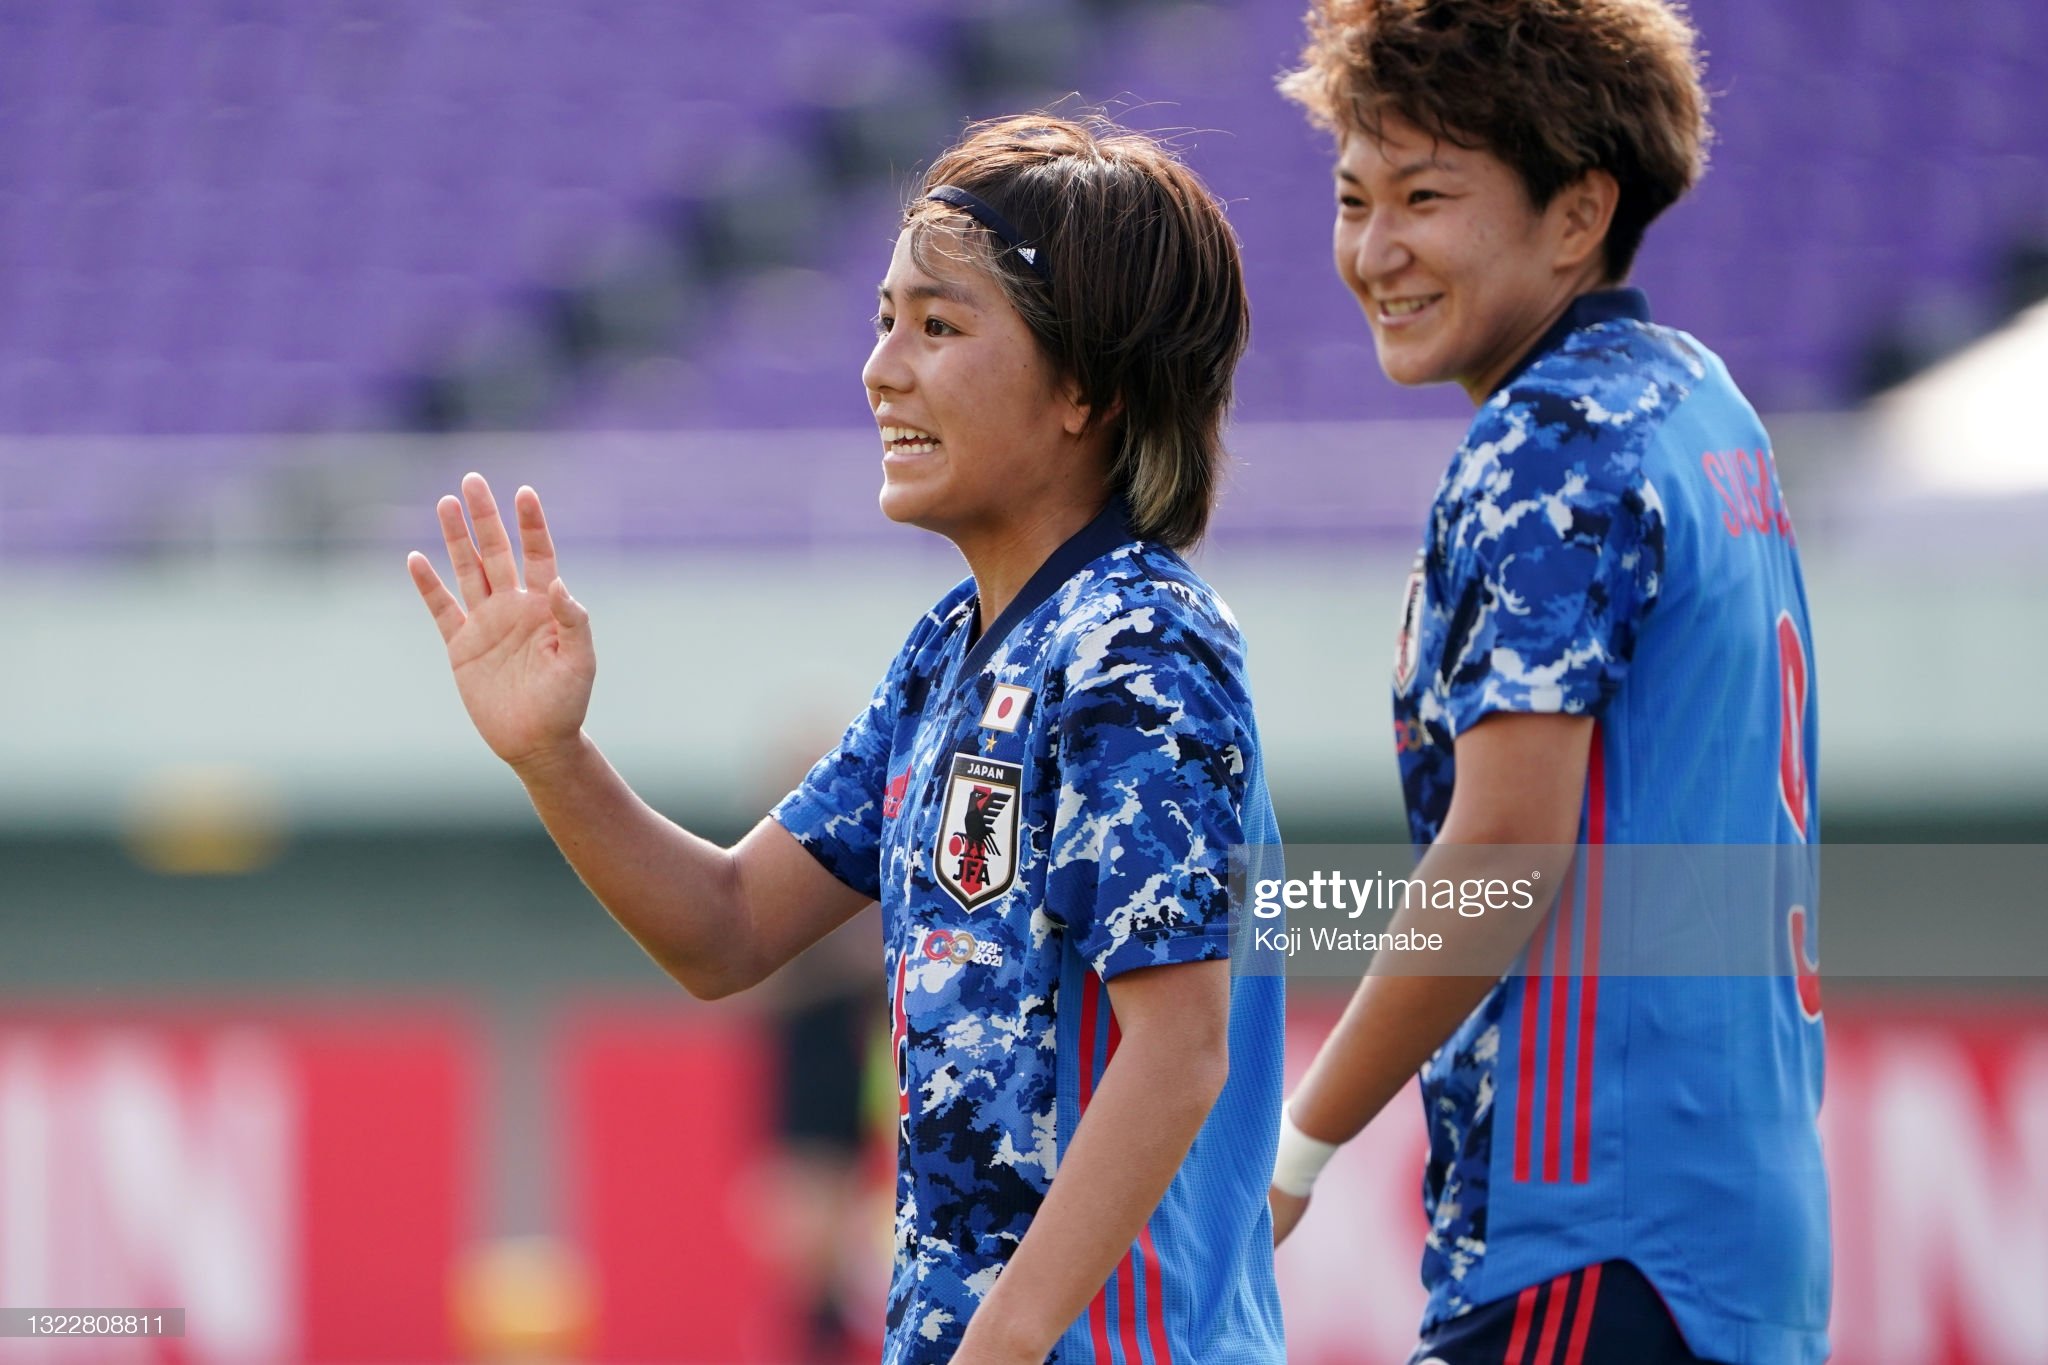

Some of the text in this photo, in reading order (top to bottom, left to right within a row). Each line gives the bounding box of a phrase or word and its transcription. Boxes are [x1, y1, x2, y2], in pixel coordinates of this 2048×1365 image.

[967, 762, 1005, 780] JAPAN
[952, 858, 991, 886] JFA
[972, 951, 1003, 968] 2021
